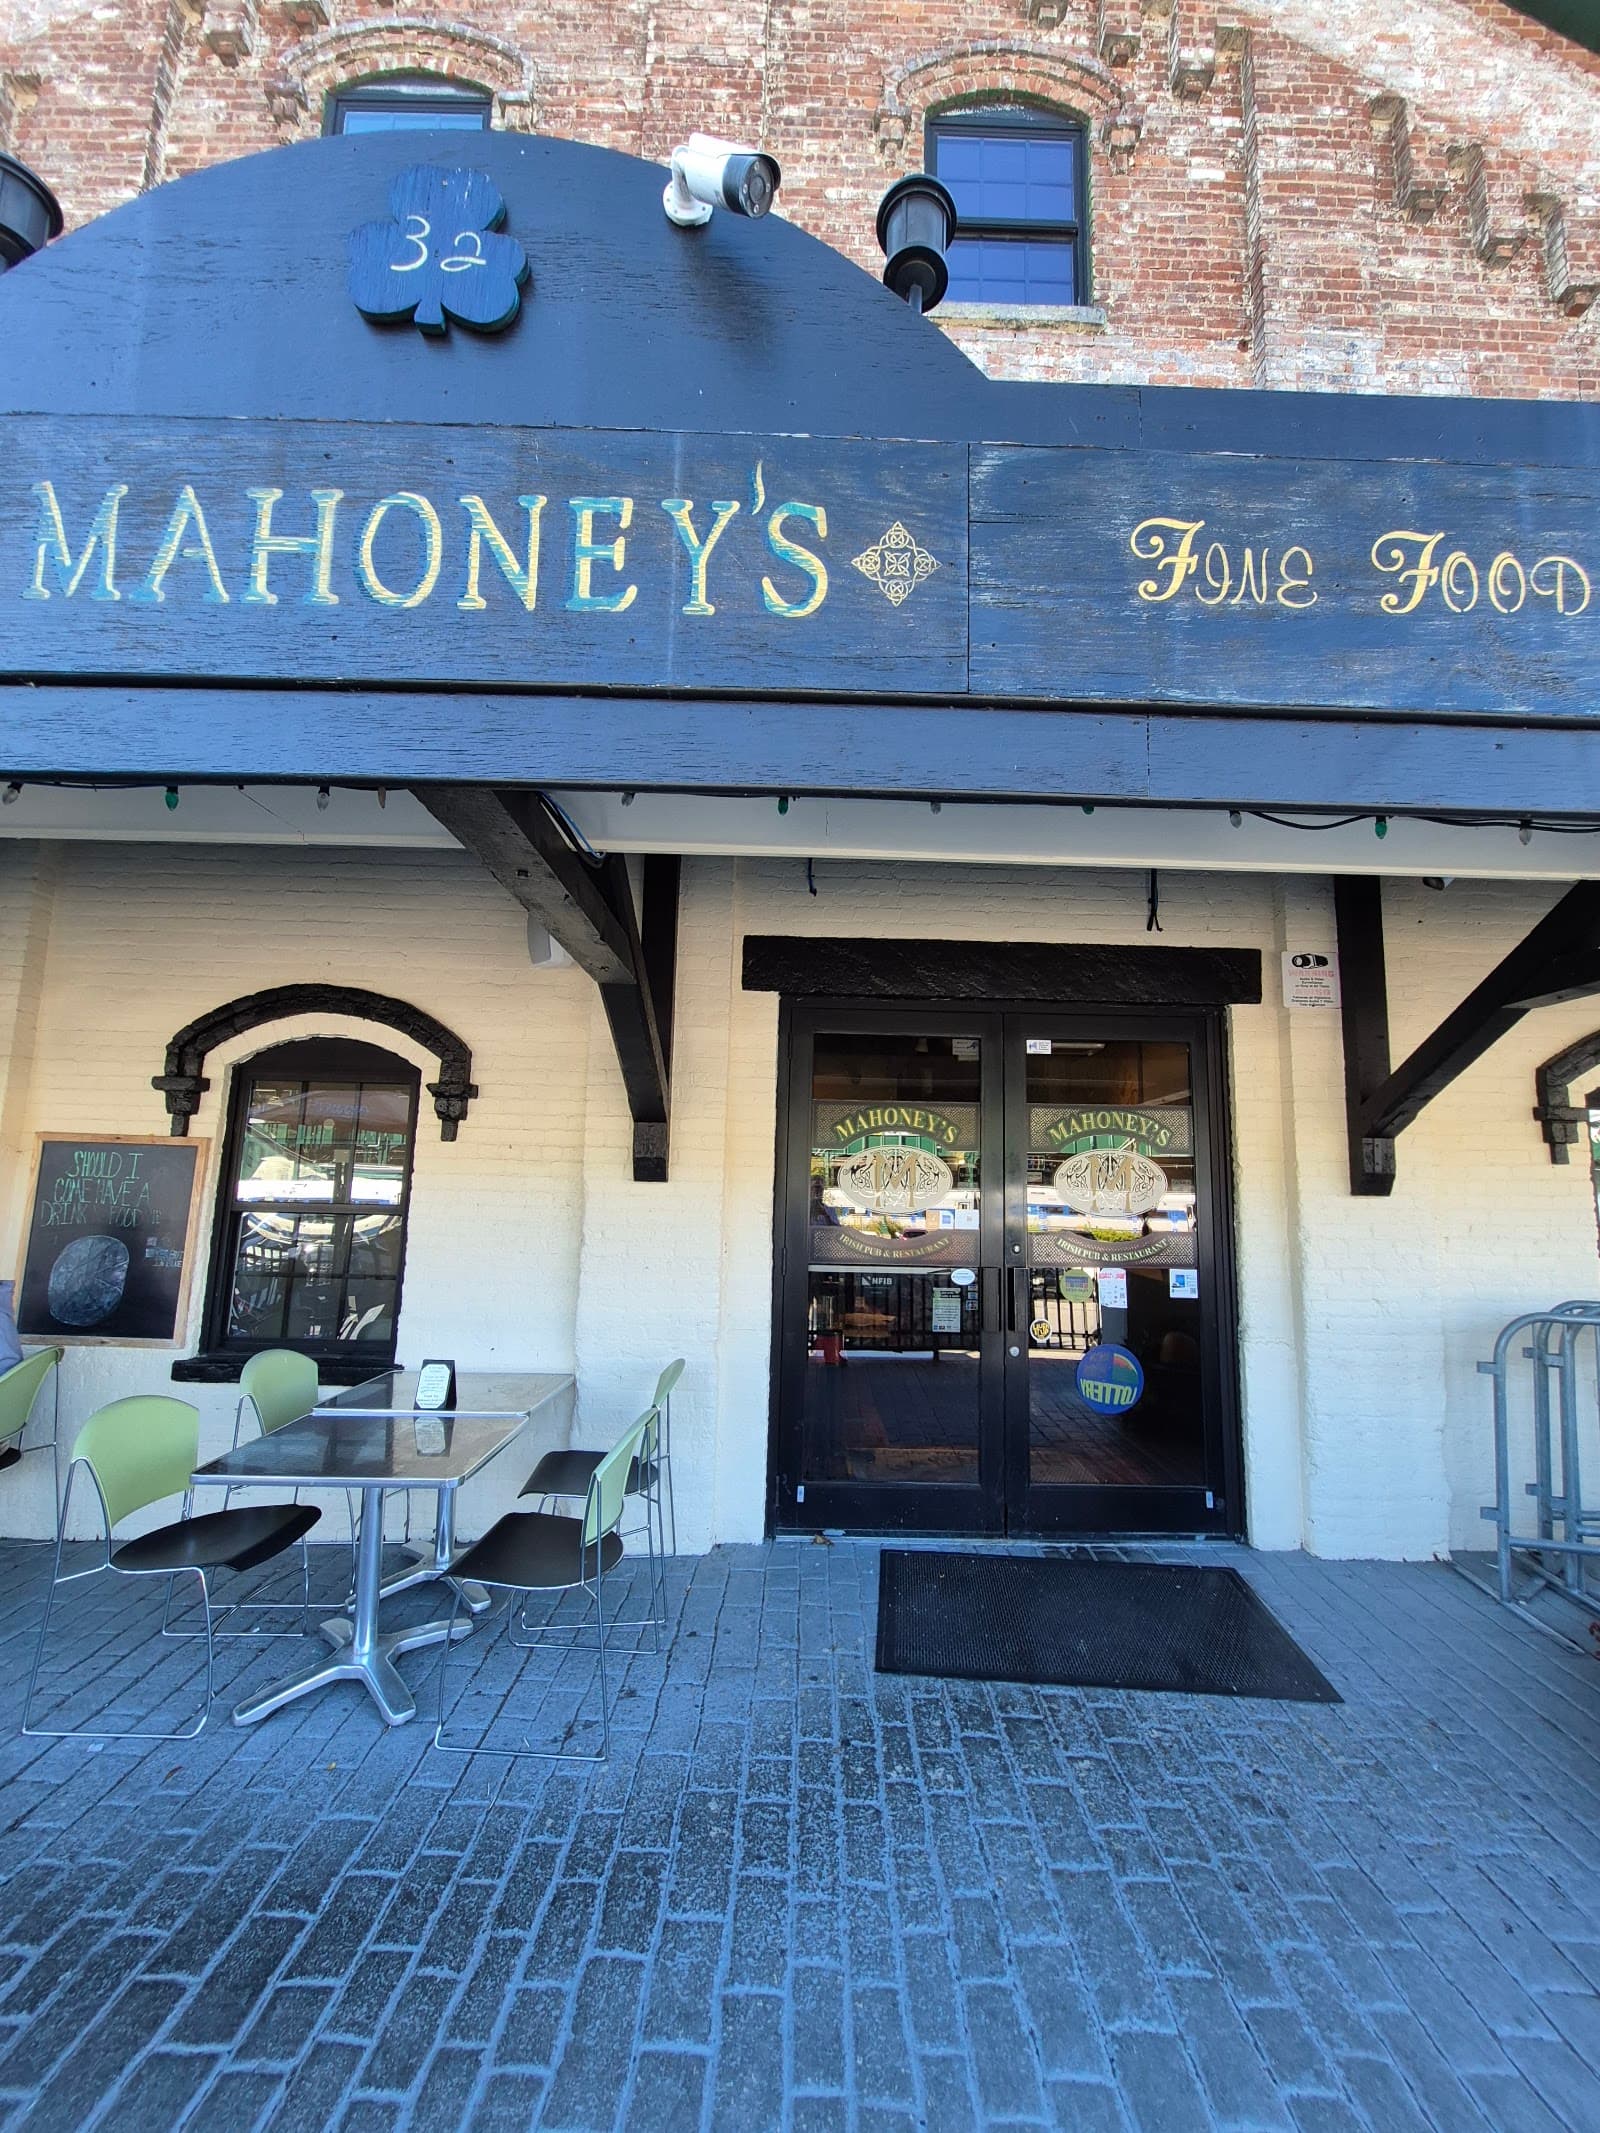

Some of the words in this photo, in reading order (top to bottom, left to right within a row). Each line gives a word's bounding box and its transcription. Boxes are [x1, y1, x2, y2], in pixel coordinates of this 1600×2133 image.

[390, 215, 487, 272] 32
[22, 459, 828, 619] MAHONEY'S
[1130, 517, 1318, 608] FINE
[1371, 530, 1592, 616] FOOD
[834, 1107, 958, 1143] MAHONEY'S
[1048, 1111, 1170, 1147] MAHONEY'S
[65, 1151, 122, 1178] SHOULD
[125, 1152, 144, 1179] I
[54, 1178, 92, 1203] COME
[95, 1179, 135, 1206] HAVE
[136, 1182, 150, 1207] A
[839, 1234, 863, 1252] IRISH
[864, 1246, 882, 1257] PUB
[883, 1249, 891, 1258] &
[892, 1237, 950, 1258] RESTAURANT
[1057, 1238, 1082, 1256] IRISH
[1081, 1249, 1100, 1260] PUB
[1101, 1252, 1110, 1262] &
[1111, 1238, 1168, 1262] RESTAURANT
